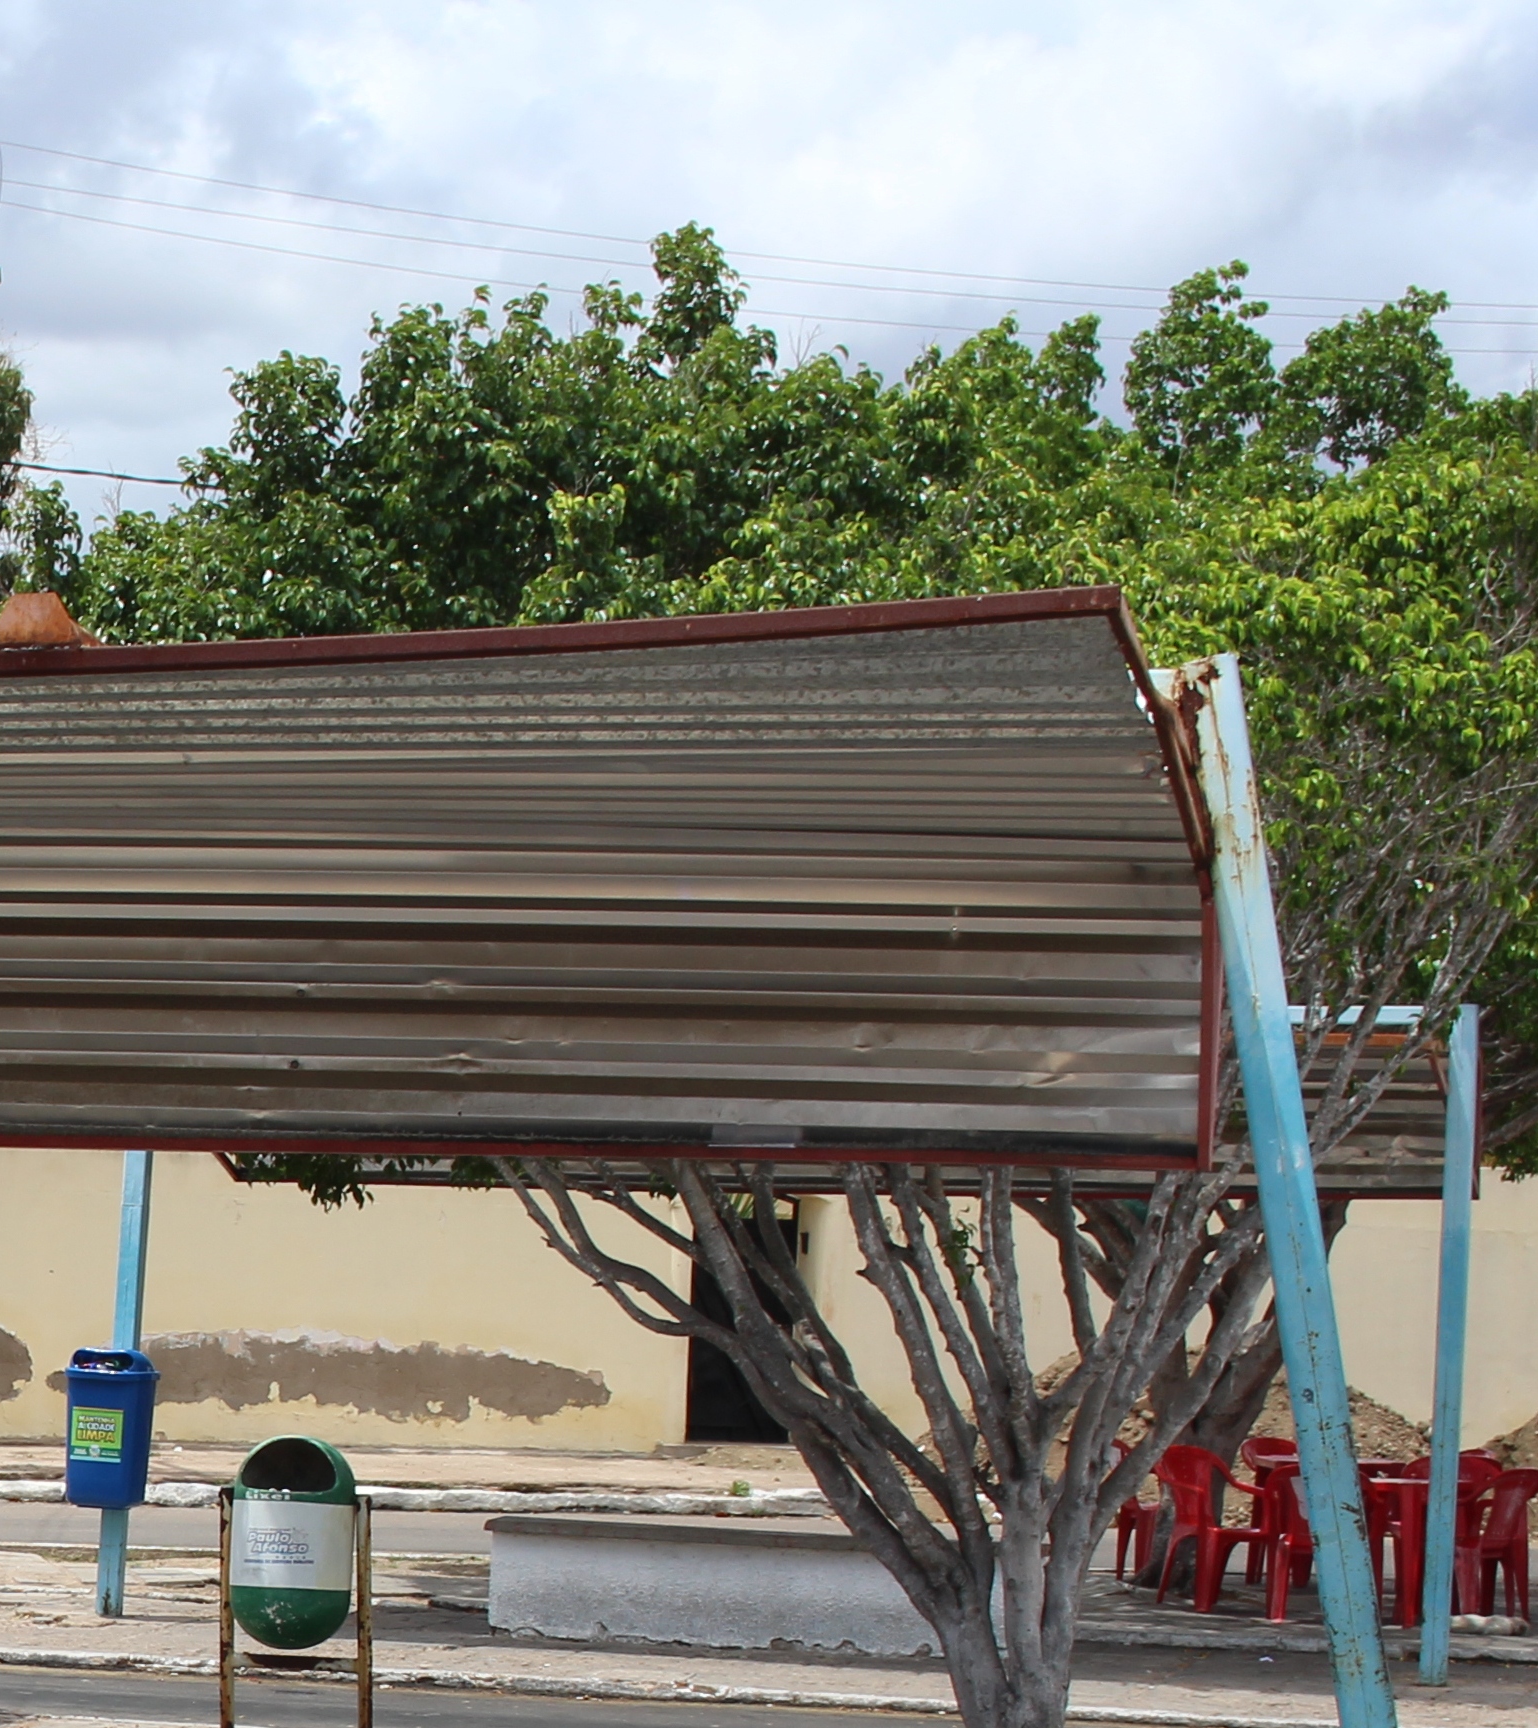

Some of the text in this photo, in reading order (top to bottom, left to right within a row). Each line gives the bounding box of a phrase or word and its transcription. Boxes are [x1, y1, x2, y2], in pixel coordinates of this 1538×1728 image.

[78, 1421, 85, 1429] A
[77, 1429, 115, 1442] LIMPA
[247, 1532, 291, 1542] Paulo
[252, 1542, 309, 1552] Afonso
